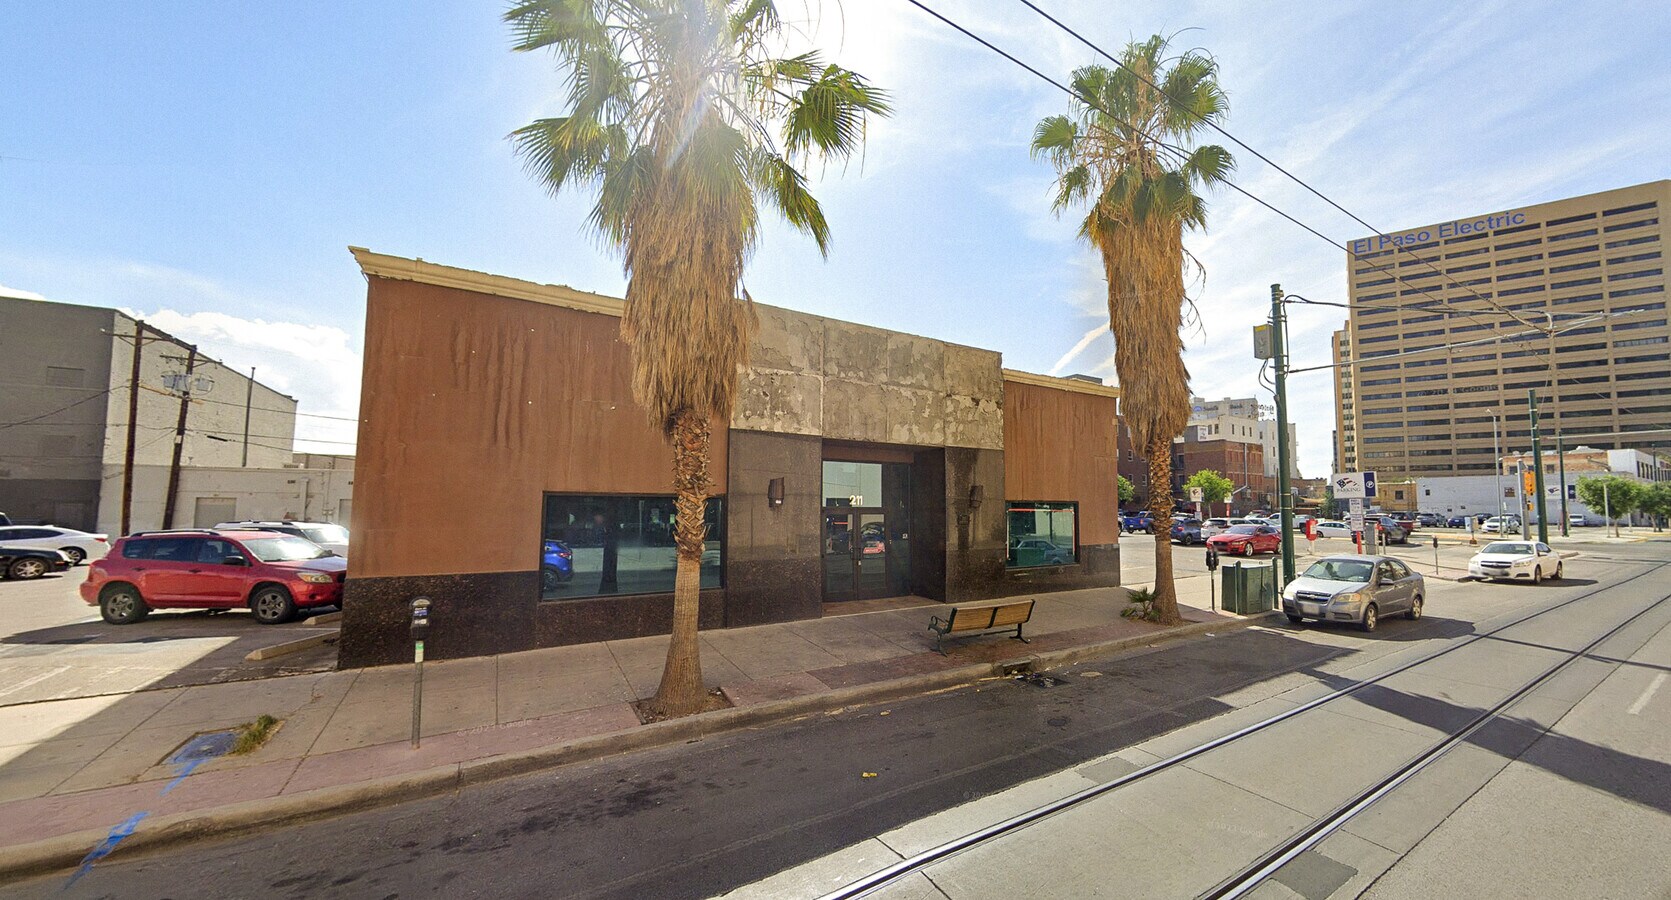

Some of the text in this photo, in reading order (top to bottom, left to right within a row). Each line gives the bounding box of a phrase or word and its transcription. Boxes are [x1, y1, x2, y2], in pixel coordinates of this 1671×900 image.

[1353, 211, 1526, 254] El Paso Electric
[849, 494, 863, 506] 211
